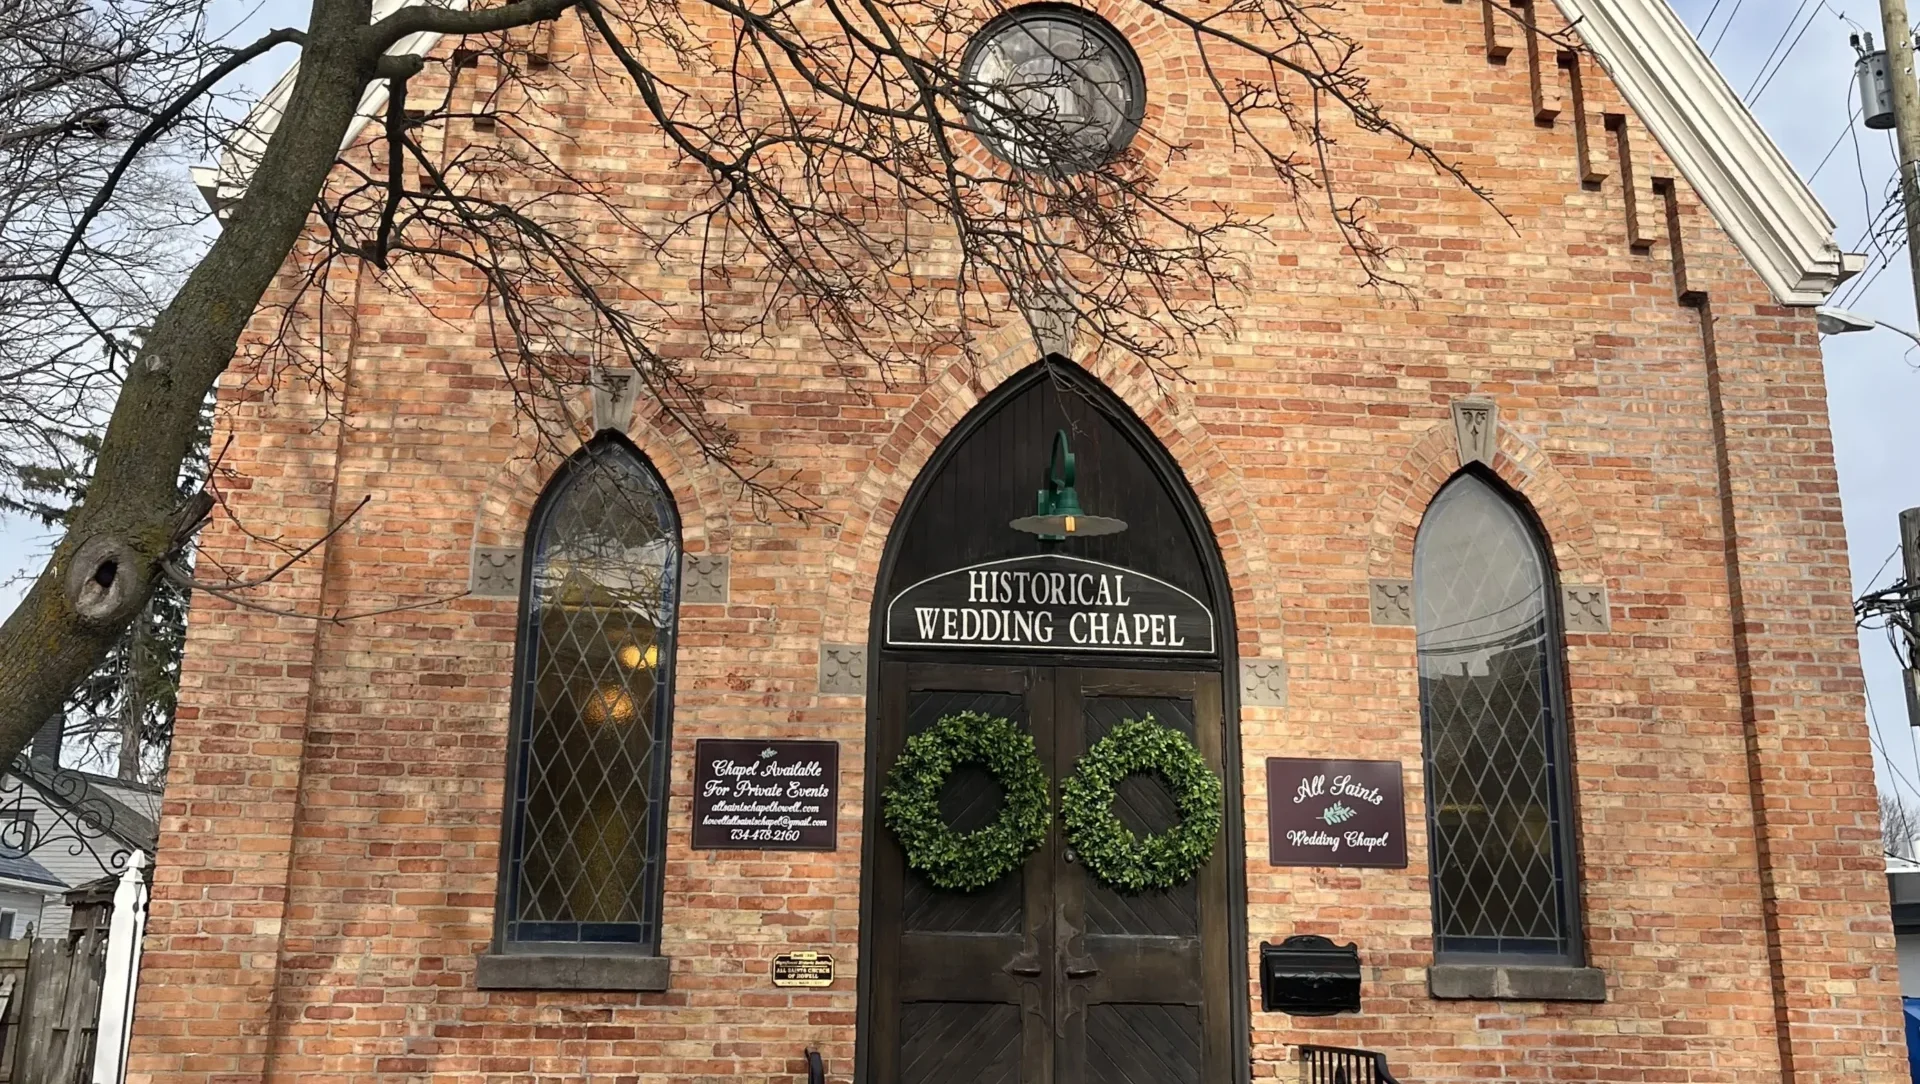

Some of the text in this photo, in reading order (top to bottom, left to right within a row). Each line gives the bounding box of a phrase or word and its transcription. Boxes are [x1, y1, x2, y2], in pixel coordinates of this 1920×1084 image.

[968, 570, 1131, 607] HISTORICAL
[914, 607, 1185, 647] WEDDING CHAPEL
[712, 760, 822, 781] Chapel Available
[703, 780, 829, 798] For Private Events
[1293, 774, 1383, 805] All Saints
[711, 800, 819, 816] allsaintschapelhowell.com
[1286, 830, 1389, 852] Wedding Chapel
